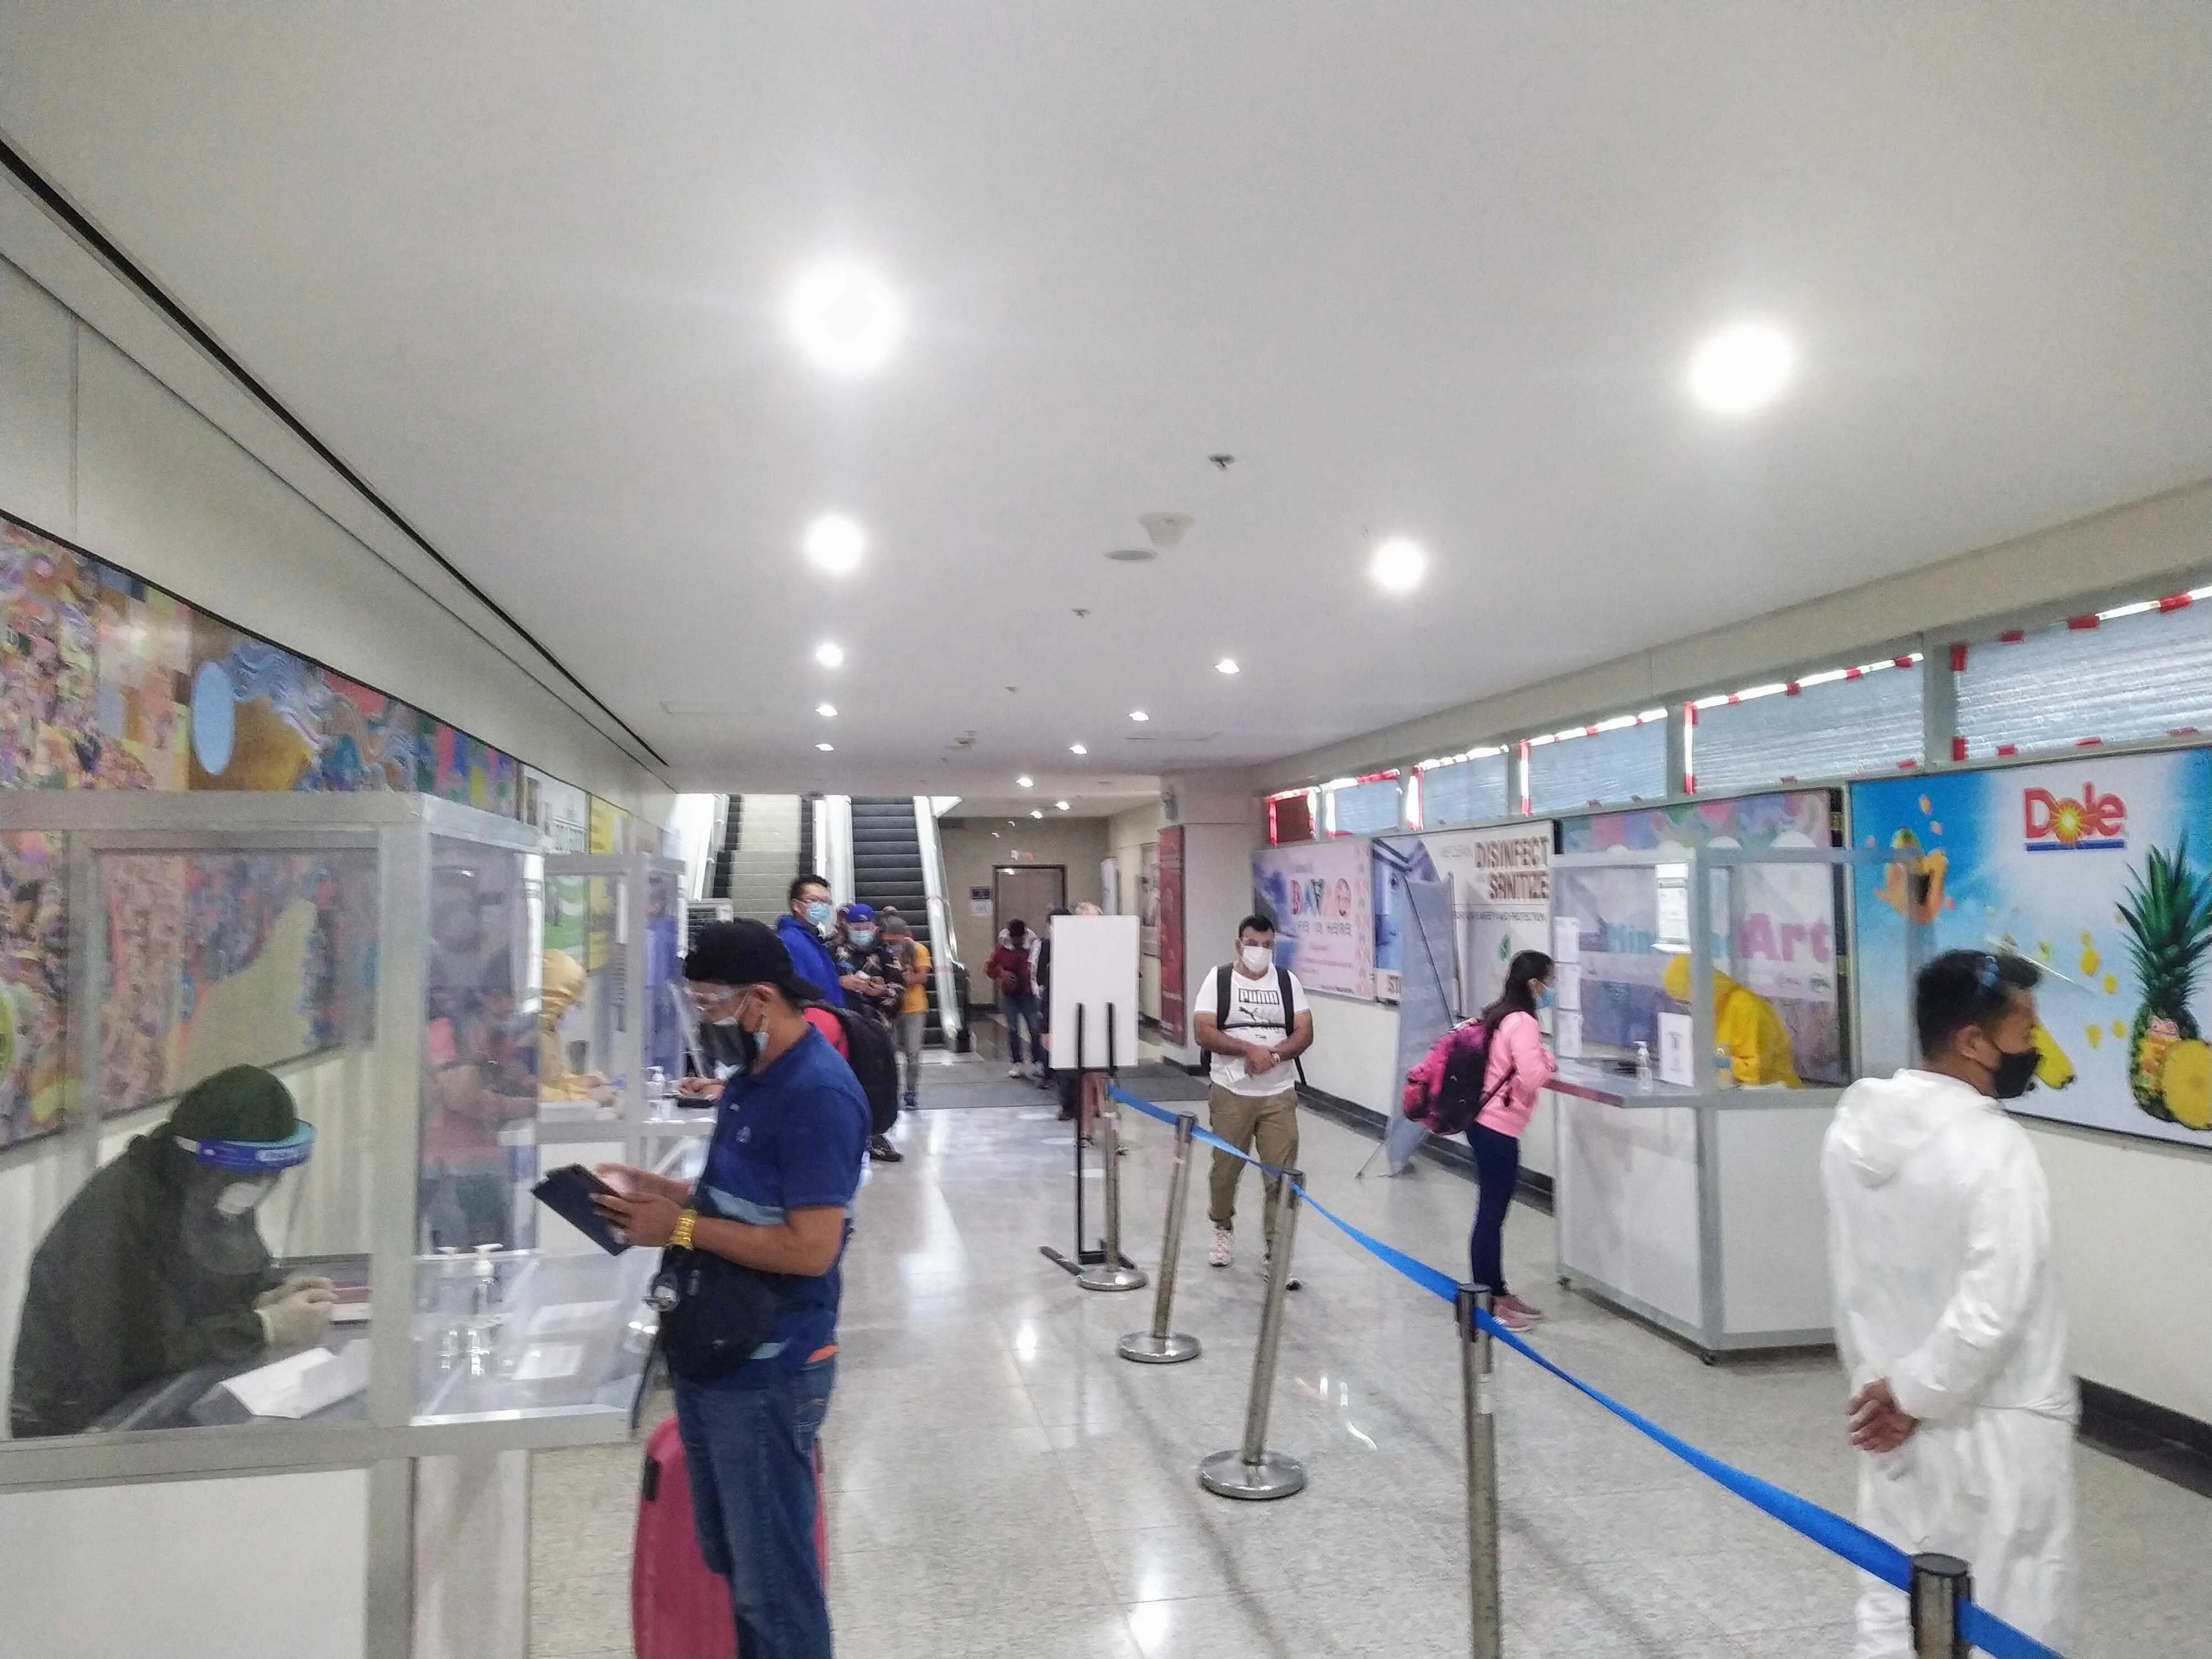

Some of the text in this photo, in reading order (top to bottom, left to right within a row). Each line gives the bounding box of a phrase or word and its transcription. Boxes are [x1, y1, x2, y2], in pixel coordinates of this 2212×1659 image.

[2024, 780, 2127, 844] Dole
[1475, 836, 1548, 868] DISINFECT
[1740, 912, 1830, 963] Art
[1240, 989, 1279, 1004] PUMA
